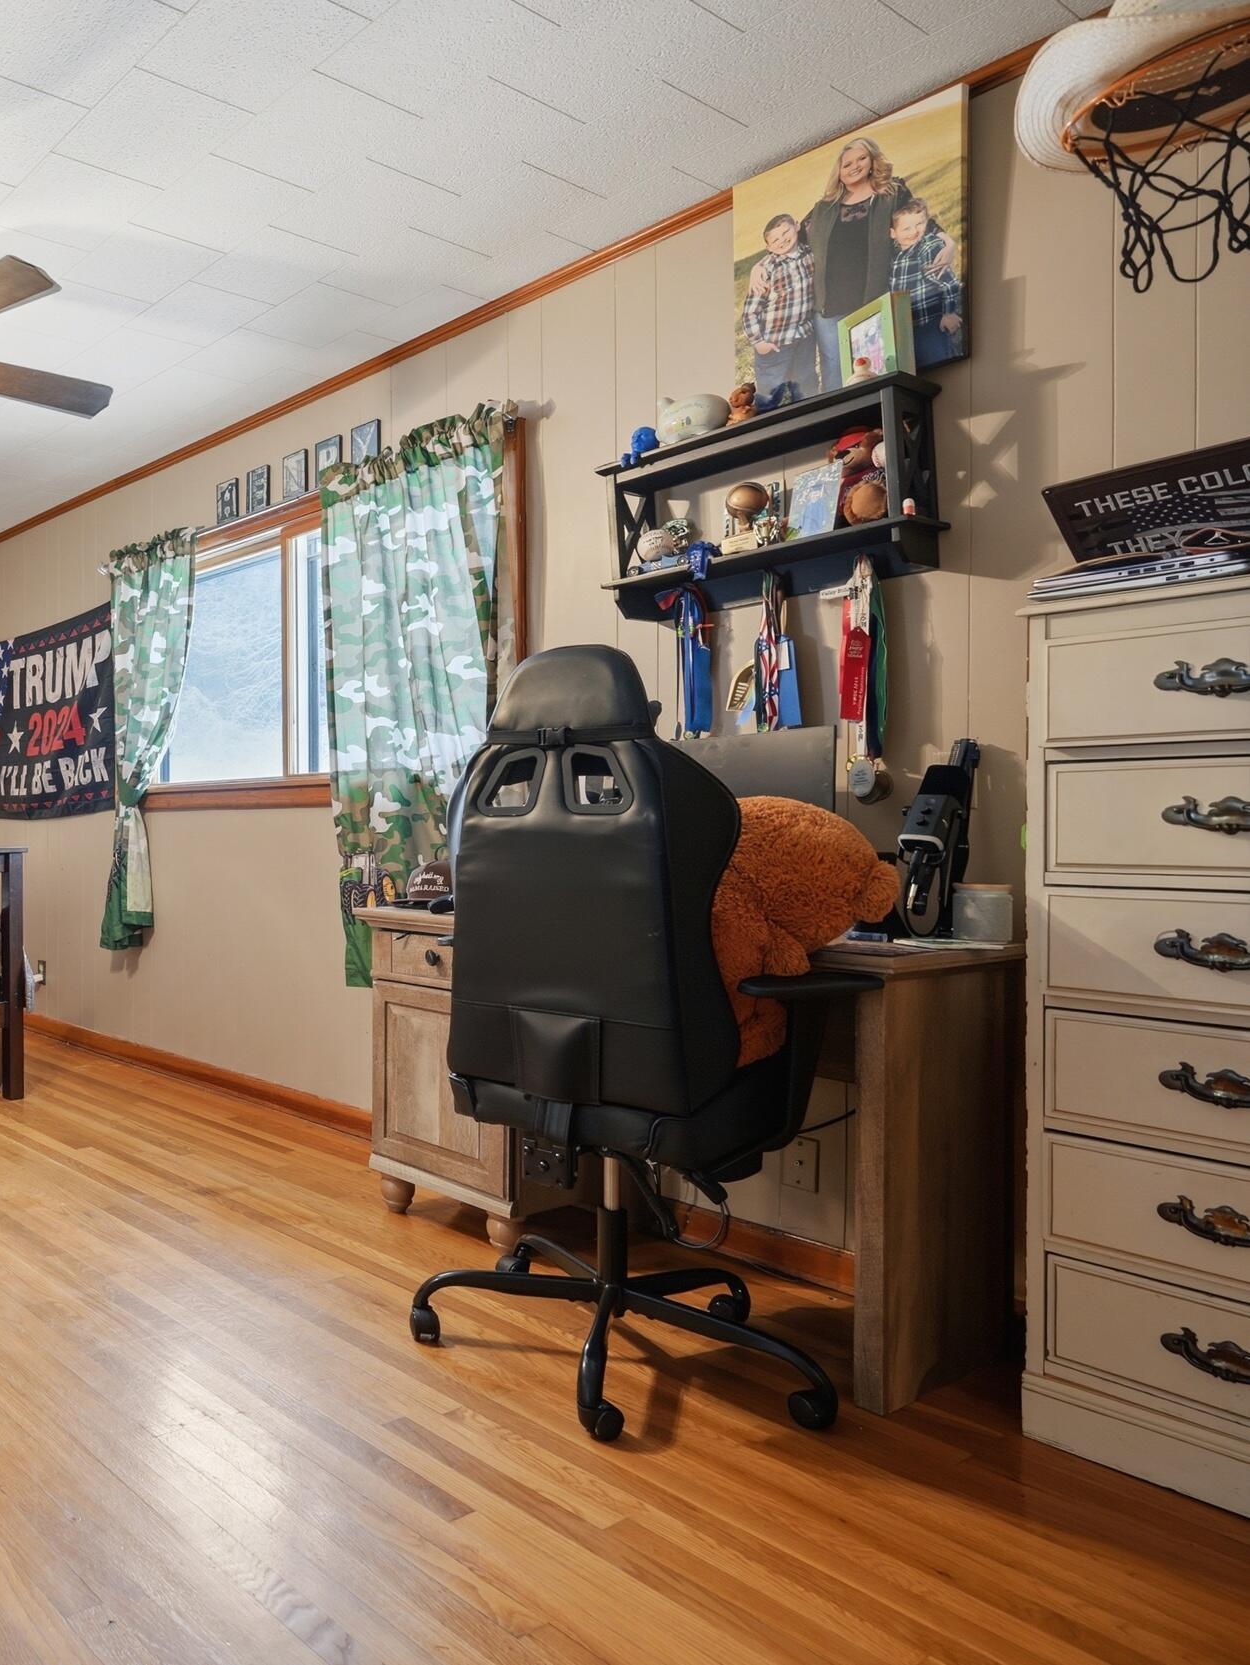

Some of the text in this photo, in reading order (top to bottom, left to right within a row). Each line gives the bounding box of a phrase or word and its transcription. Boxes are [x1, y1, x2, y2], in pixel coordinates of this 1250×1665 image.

[1074, 482, 1173, 517] THESE
[1107, 529, 1183, 556] THEY
[9, 629, 112, 710] TRUMP
[26, 701, 86, 757] 2024
[0, 765, 27, 796] I'LL
[32, 759, 57, 795] BE
